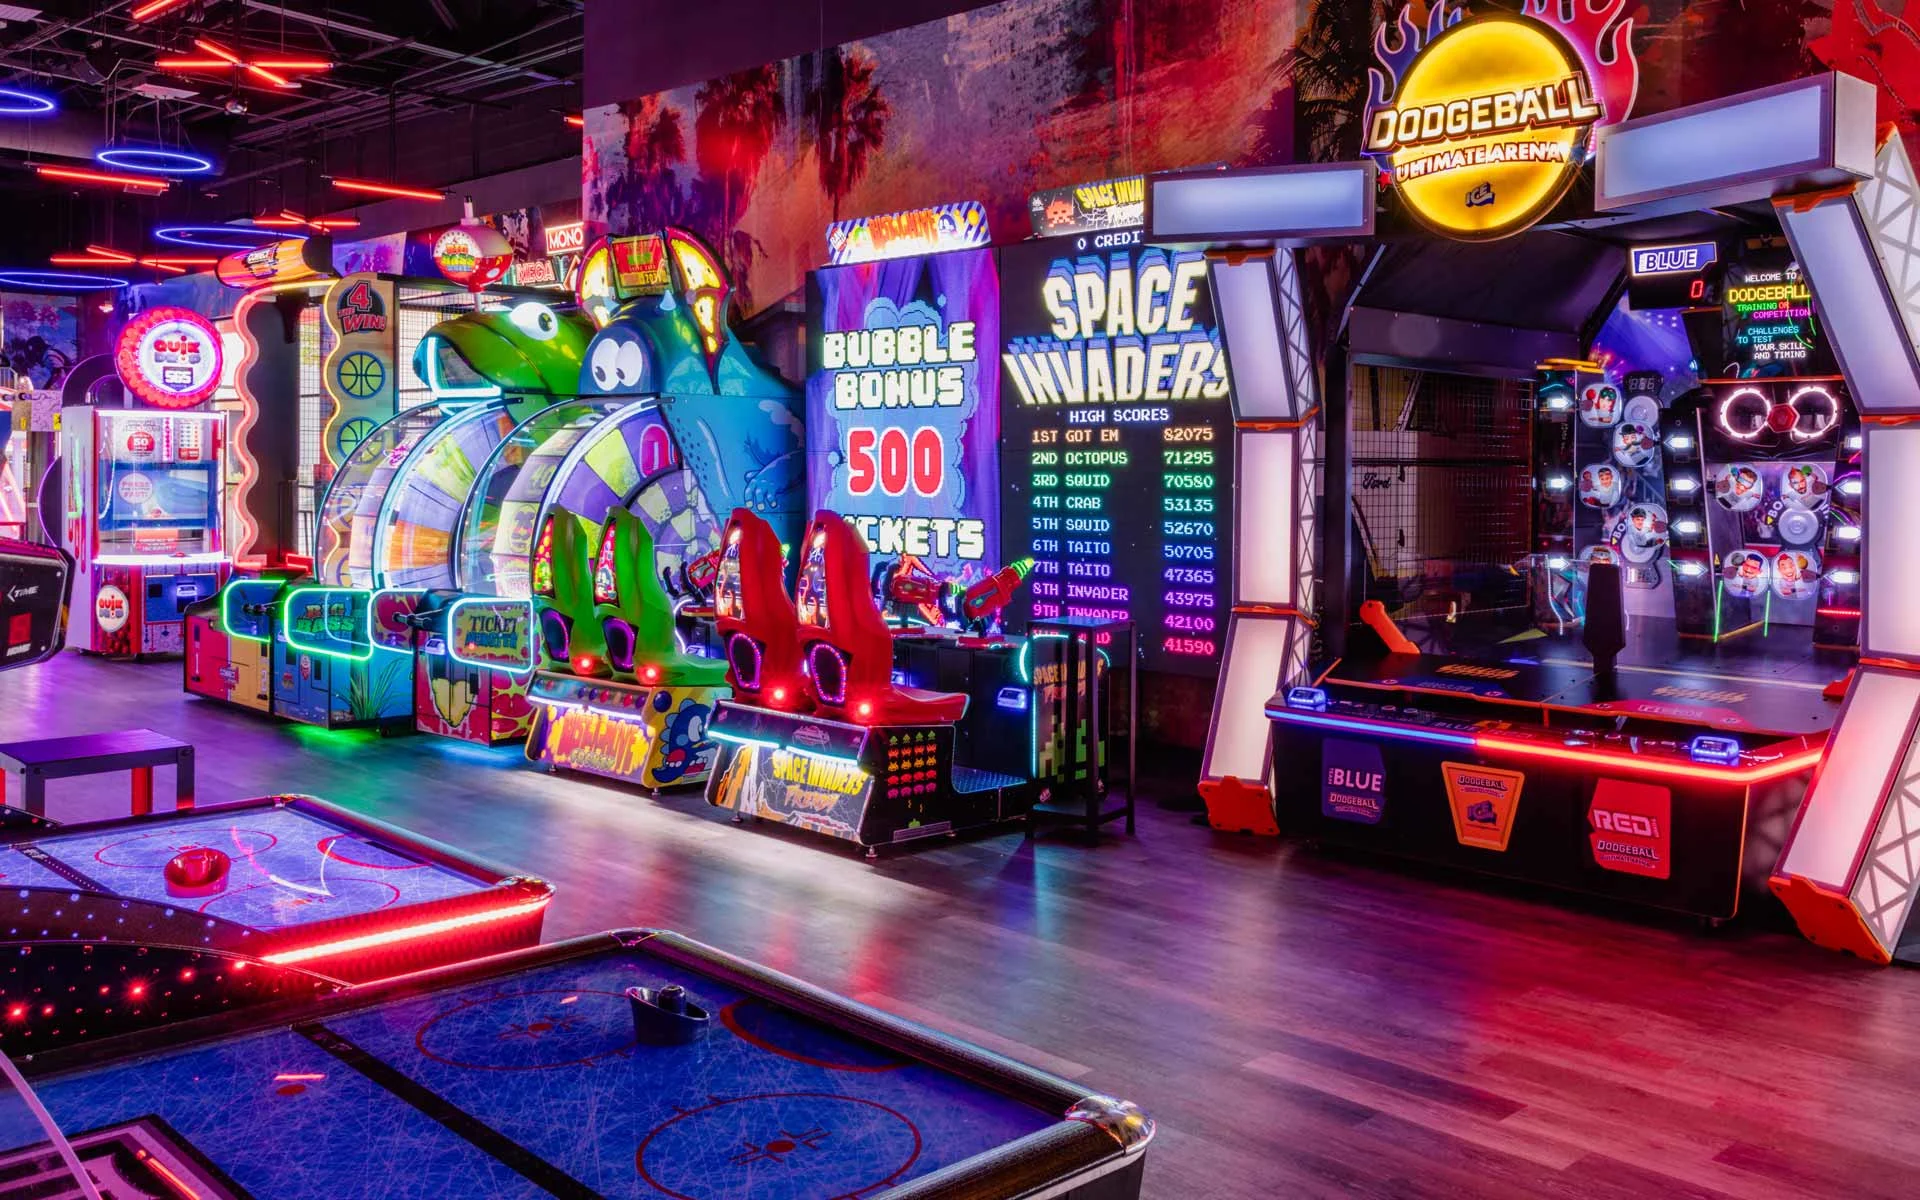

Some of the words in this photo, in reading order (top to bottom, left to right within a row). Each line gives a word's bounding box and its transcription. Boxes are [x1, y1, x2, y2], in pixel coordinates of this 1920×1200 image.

[1367, 74, 1602, 151] DODGEBALL
[1396, 146, 1486, 182] ULTIMATE
[1486, 141, 1568, 166] ARENA
[1076, 182, 1116, 210] SPACE
[1114, 178, 1144, 204] INVA
[1465, 182, 1495, 207] ICE
[549, 227, 583, 249] MONO
[1094, 230, 1144, 248] CREDI
[1645, 248, 1698, 271] BLUE
[516, 261, 555, 282] MEGA
[1745, 273, 1781, 283] WELCOME
[1786, 271, 1797, 280] TO
[348, 281, 372, 311] 4
[1043, 255, 1208, 341] SPACE
[1690, 280, 1704, 298] 0
[1728, 284, 1811, 303] DODGEBALL
[1737, 302, 1778, 312] TRAINING
[1778, 301, 1790, 310] OR
[1753, 309, 1810, 319] COMPETITION
[343, 314, 386, 334] WIN!
[1748, 326, 1799, 336] CHALLENGES
[824, 321, 976, 369] BUBBLE
[1738, 336, 1748, 344] TO
[1752, 335, 1773, 343] TEST
[1754, 343, 1776, 352] YOUR
[1779, 342, 1806, 351] SKILL
[1754, 352, 1770, 360] AND
[1774, 350, 1806, 359] TIMING
[1003, 336, 1230, 406] INVADERS
[835, 367, 965, 410] BONUS
[1069, 408, 1105, 422] HIGH
[1113, 408, 1169, 422] SCORES
[1032, 430, 1058, 443] 1ST
[1066, 430, 1092, 443] GOT
[1101, 429, 1119, 442] EM
[1163, 428, 1213, 442] 82075
[847, 426, 944, 498] 500
[1032, 452, 1058, 465] 2ND
[1066, 451, 1128, 465] OCTOPUS
[1163, 451, 1213, 465] 71295
[1032, 474, 1058, 487] 3RD
[1066, 474, 1110, 488] SQUID
[1163, 475, 1213, 489] 70580
[1363, 472, 1391, 490] Ford
[1032, 496, 1058, 509] 4TH
[1066, 496, 1101, 510] CRAB
[1163, 498, 1213, 512] 53135
[1032, 518, 1058, 531] 5TH
[1066, 518, 1110, 533] SQUID
[1163, 521, 1213, 536] 52670
[844, 514, 984, 560] CKETS
[1032, 540, 1058, 552] 6TH
[1067, 540, 1110, 554] TAITO
[1163, 545, 1213, 559] 50705
[1032, 561, 1058, 574] 7TH
[1067, 563, 1111, 577] TAITO
[1163, 568, 1213, 583] 47365
[14, 586, 39, 598] TIME
[1032, 583, 1058, 597] 8TH
[1067, 584, 1129, 600] INVADER
[1163, 592, 1213, 607] 43975
[470, 615, 518, 633] TICKET
[1032, 604, 1058, 617] 9TH
[1163, 616, 1213, 631] 42100
[1164, 640, 1214, 656] 41590
[771, 751, 810, 785] SPACE
[806, 759, 869, 796] INVADERS
[1333, 768, 1382, 792] BLUE
[1457, 774, 1508, 792] DODGEBALL
[1329, 792, 1380, 810] DODGEBALL
[1593, 809, 1652, 836] RED
[1597, 840, 1660, 860] DODGEBALL
